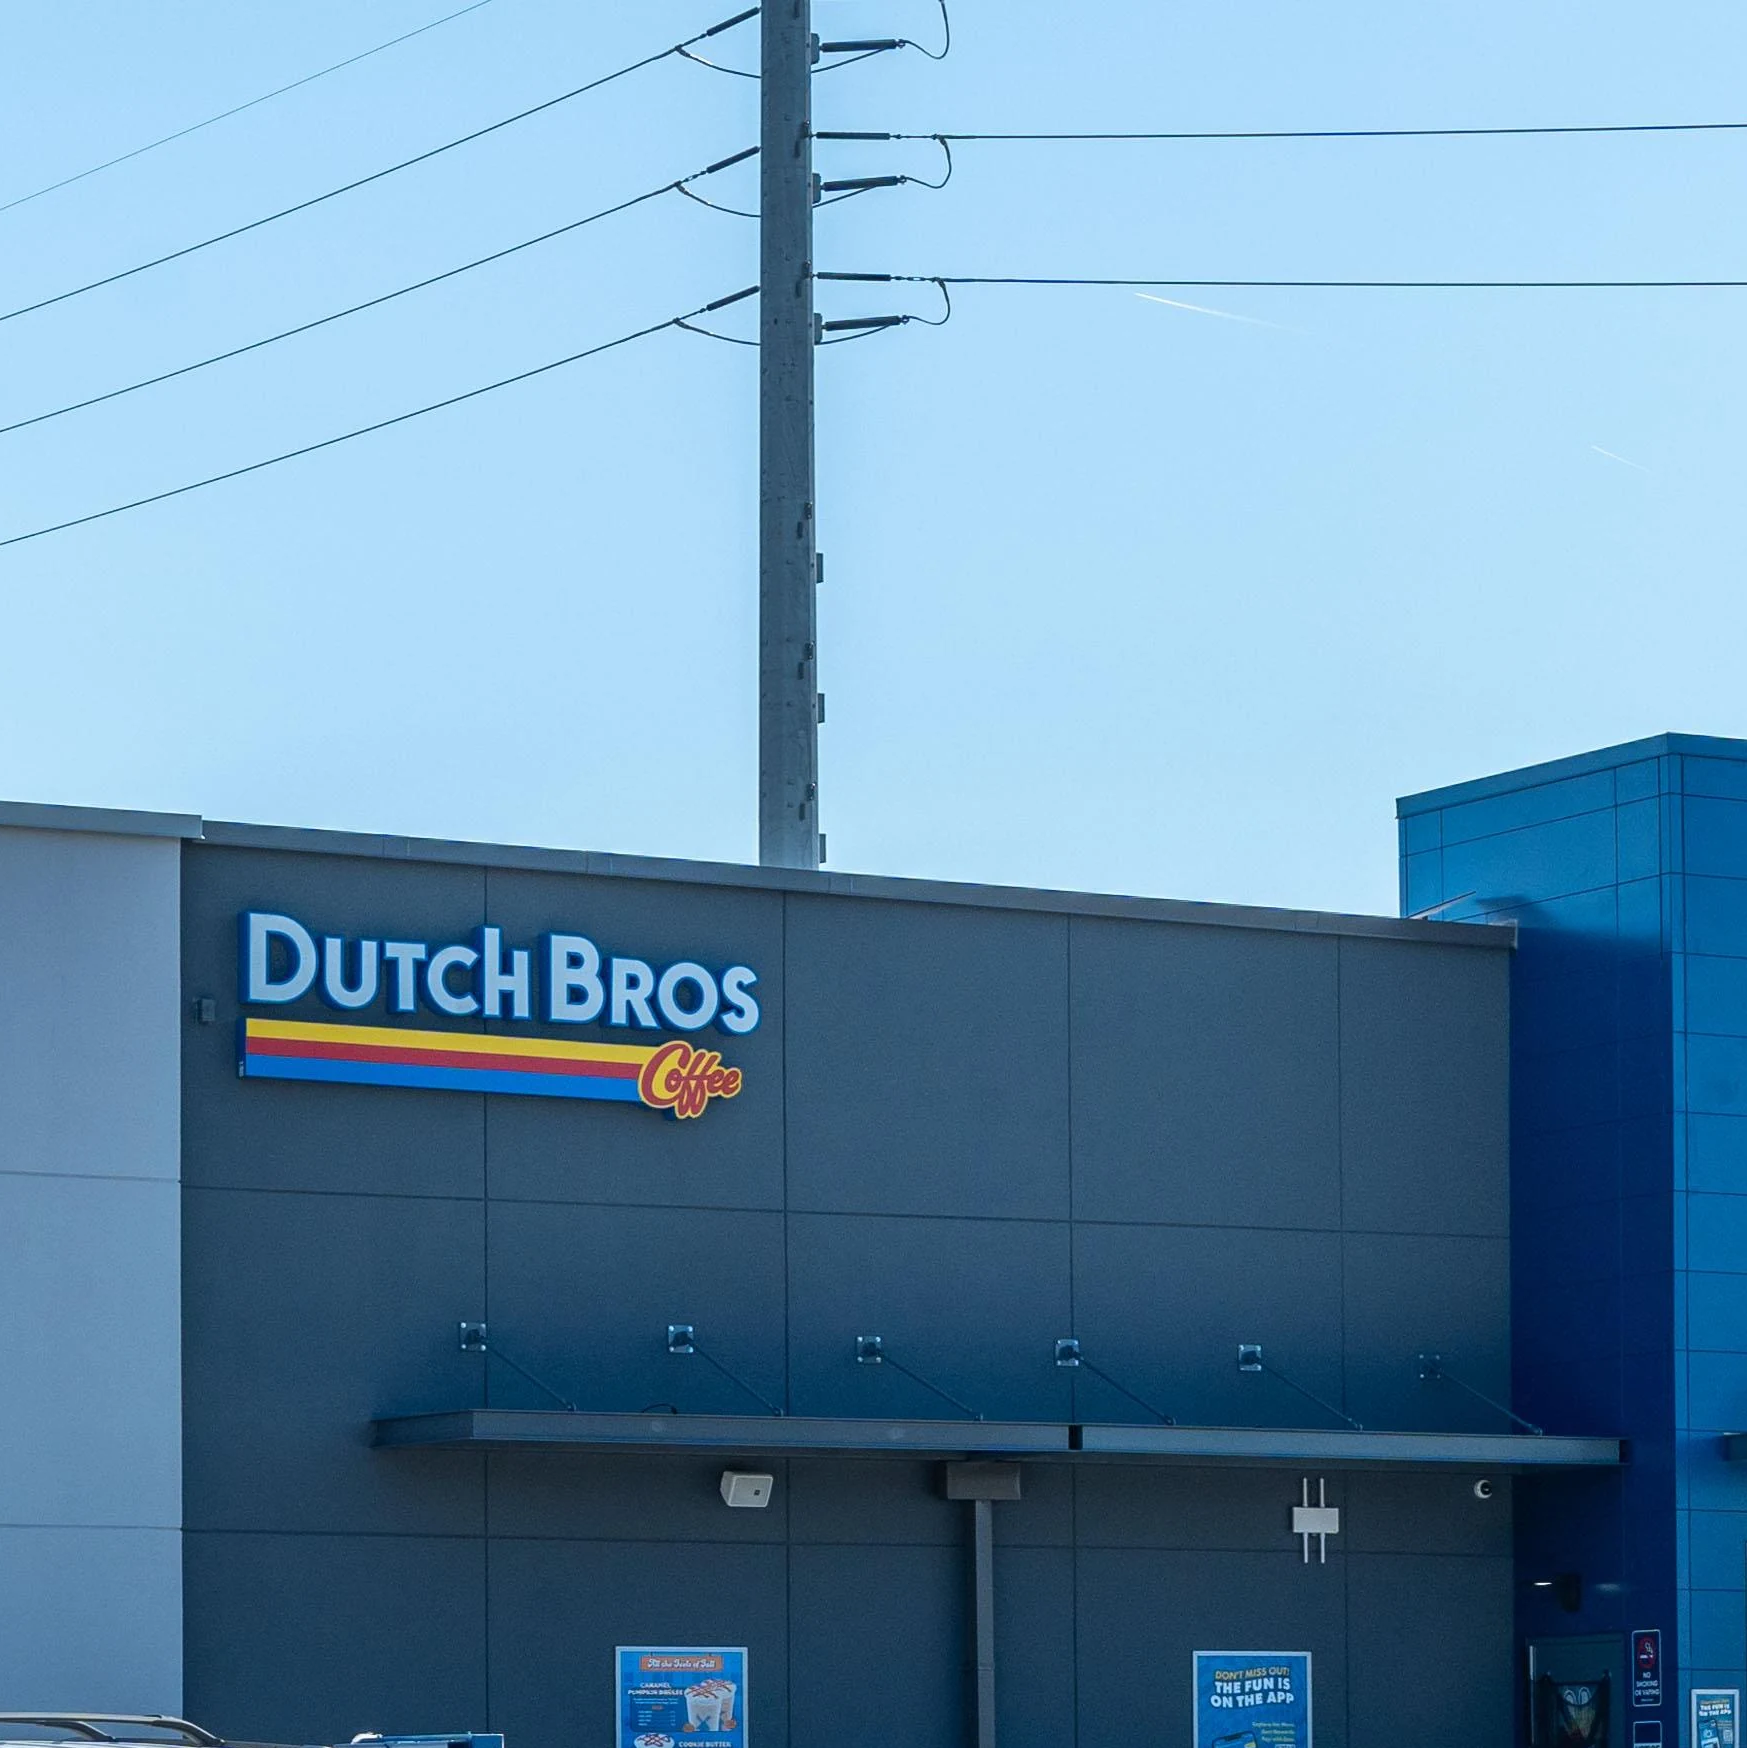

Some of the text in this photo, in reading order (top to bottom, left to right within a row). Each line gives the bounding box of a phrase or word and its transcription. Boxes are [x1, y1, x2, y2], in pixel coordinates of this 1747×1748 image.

[550, 934, 761, 1035] BROS
[640, 1041, 742, 1120] Coffee
[1215, 1666, 1290, 1681] DON'T MISS OUT!
[1642, 1671, 1652, 1679] NO
[1214, 1677, 1291, 1695] THE FUN IS
[1636, 1680, 1659, 1688] SMOKING
[1210, 1691, 1295, 1708] ON THE APP
